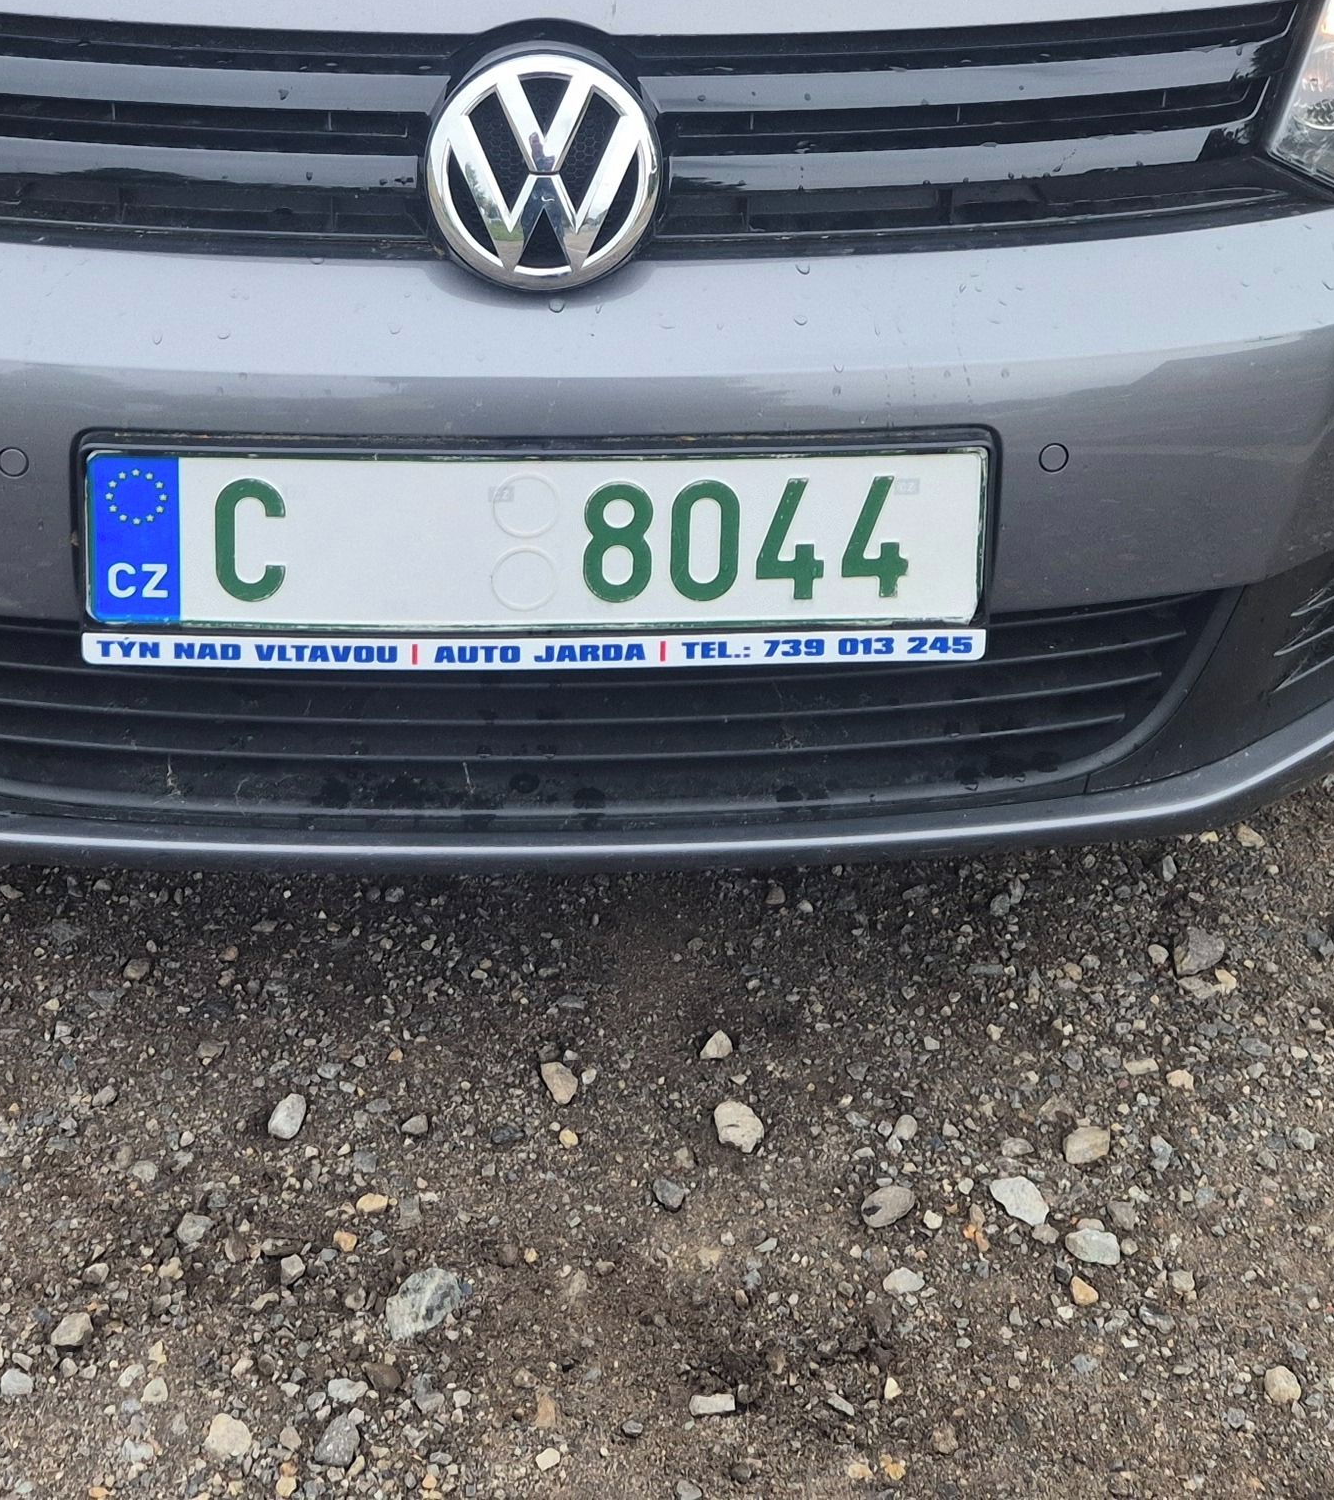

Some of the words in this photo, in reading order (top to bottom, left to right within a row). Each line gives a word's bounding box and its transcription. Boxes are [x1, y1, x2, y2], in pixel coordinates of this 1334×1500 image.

[214, 477, 286, 602] C
[582, 475, 909, 603] 8044
[107, 562, 169, 599] CZ
[96, 636, 161, 659] TÝN
[173, 642, 242, 661] NAD
[254, 643, 398, 664] VLTAVOU
[433, 645, 521, 664] AUTO
[533, 643, 646, 663] JARDA
[681, 640, 752, 660] TEL.:
[763, 638, 826, 658] 739
[837, 636, 895, 656] 013
[906, 636, 973, 656] 245
